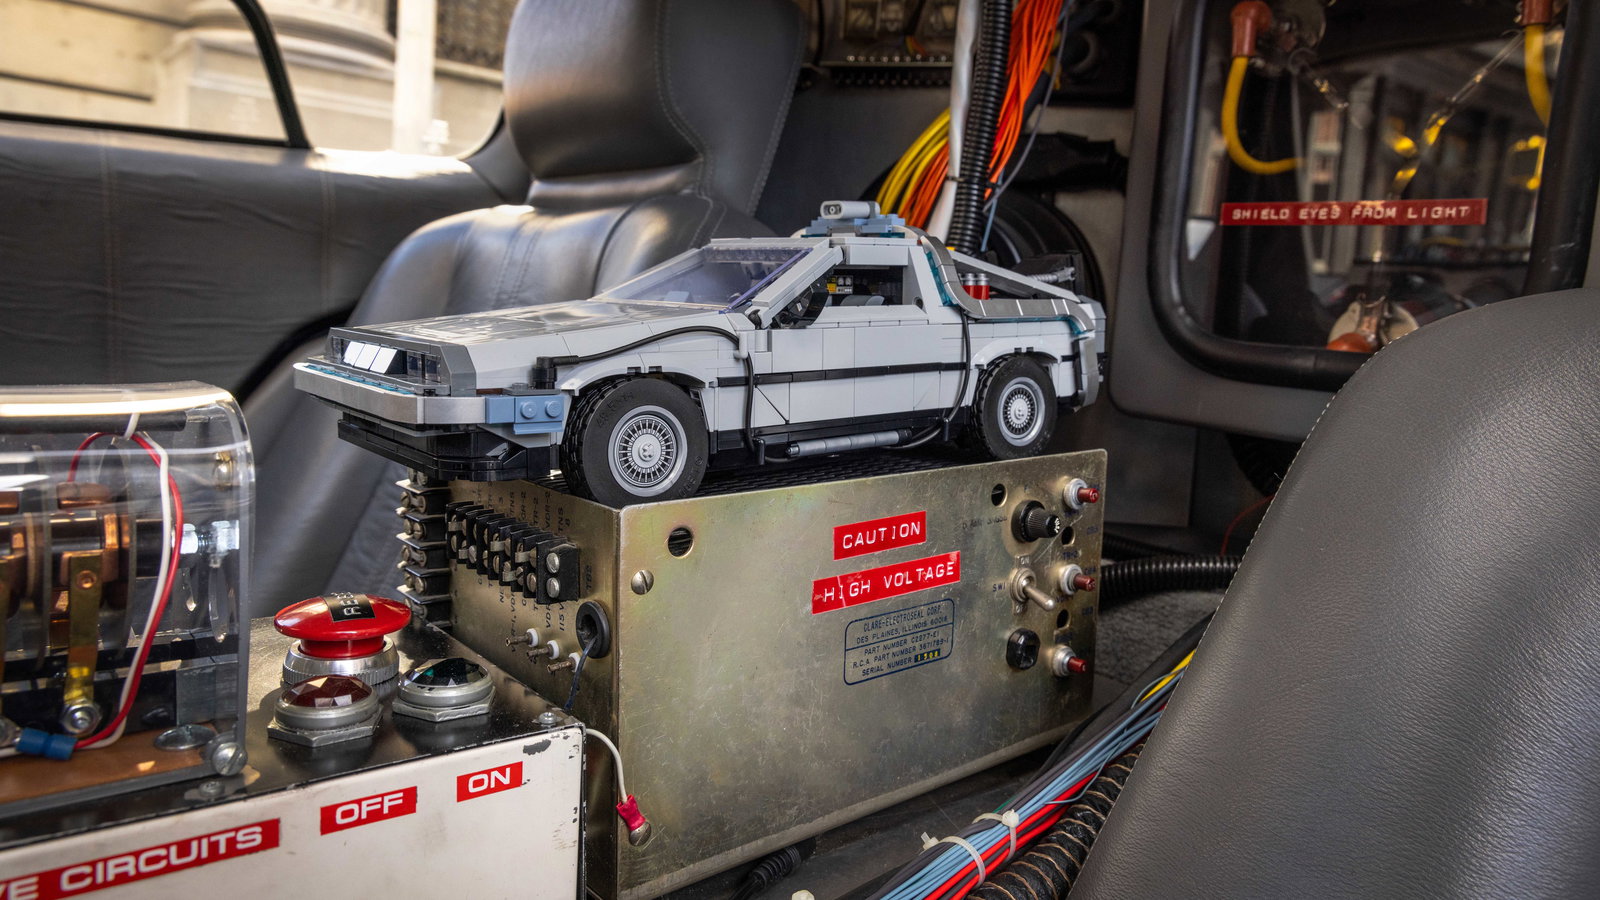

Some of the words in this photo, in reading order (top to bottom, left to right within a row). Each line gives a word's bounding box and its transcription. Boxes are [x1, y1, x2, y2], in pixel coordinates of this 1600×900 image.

[1232, 208, 1289, 220] SHIELD
[1299, 207, 1341, 220] EYES
[1351, 205, 1397, 220] FROM
[1407, 206, 1469, 219] LIGHT
[842, 521, 921, 549] CAUTION
[823, 580, 871, 603] HIGH
[884, 561, 955, 589] VOLTAGE
[857, 636, 869, 645] DES
[872, 630, 901, 641] PLAINES,
[902, 621, 927, 632] ILLINOIS
[863, 610, 924, 632] CLARE-ELECTROSEAL
[864, 646, 880, 655] PART
[883, 638, 908, 650] NUMBER
[874, 653, 890, 662] PART
[892, 646, 916, 657] NUMBER
[862, 666, 884, 676] SERIAL
[887, 657, 912, 669] NUMBER
[467, 767, 511, 794] ON
[335, 792, 404, 825] OFF
[0, 876, 39, 900] E
[60, 826, 262, 891] CIRCUITS
